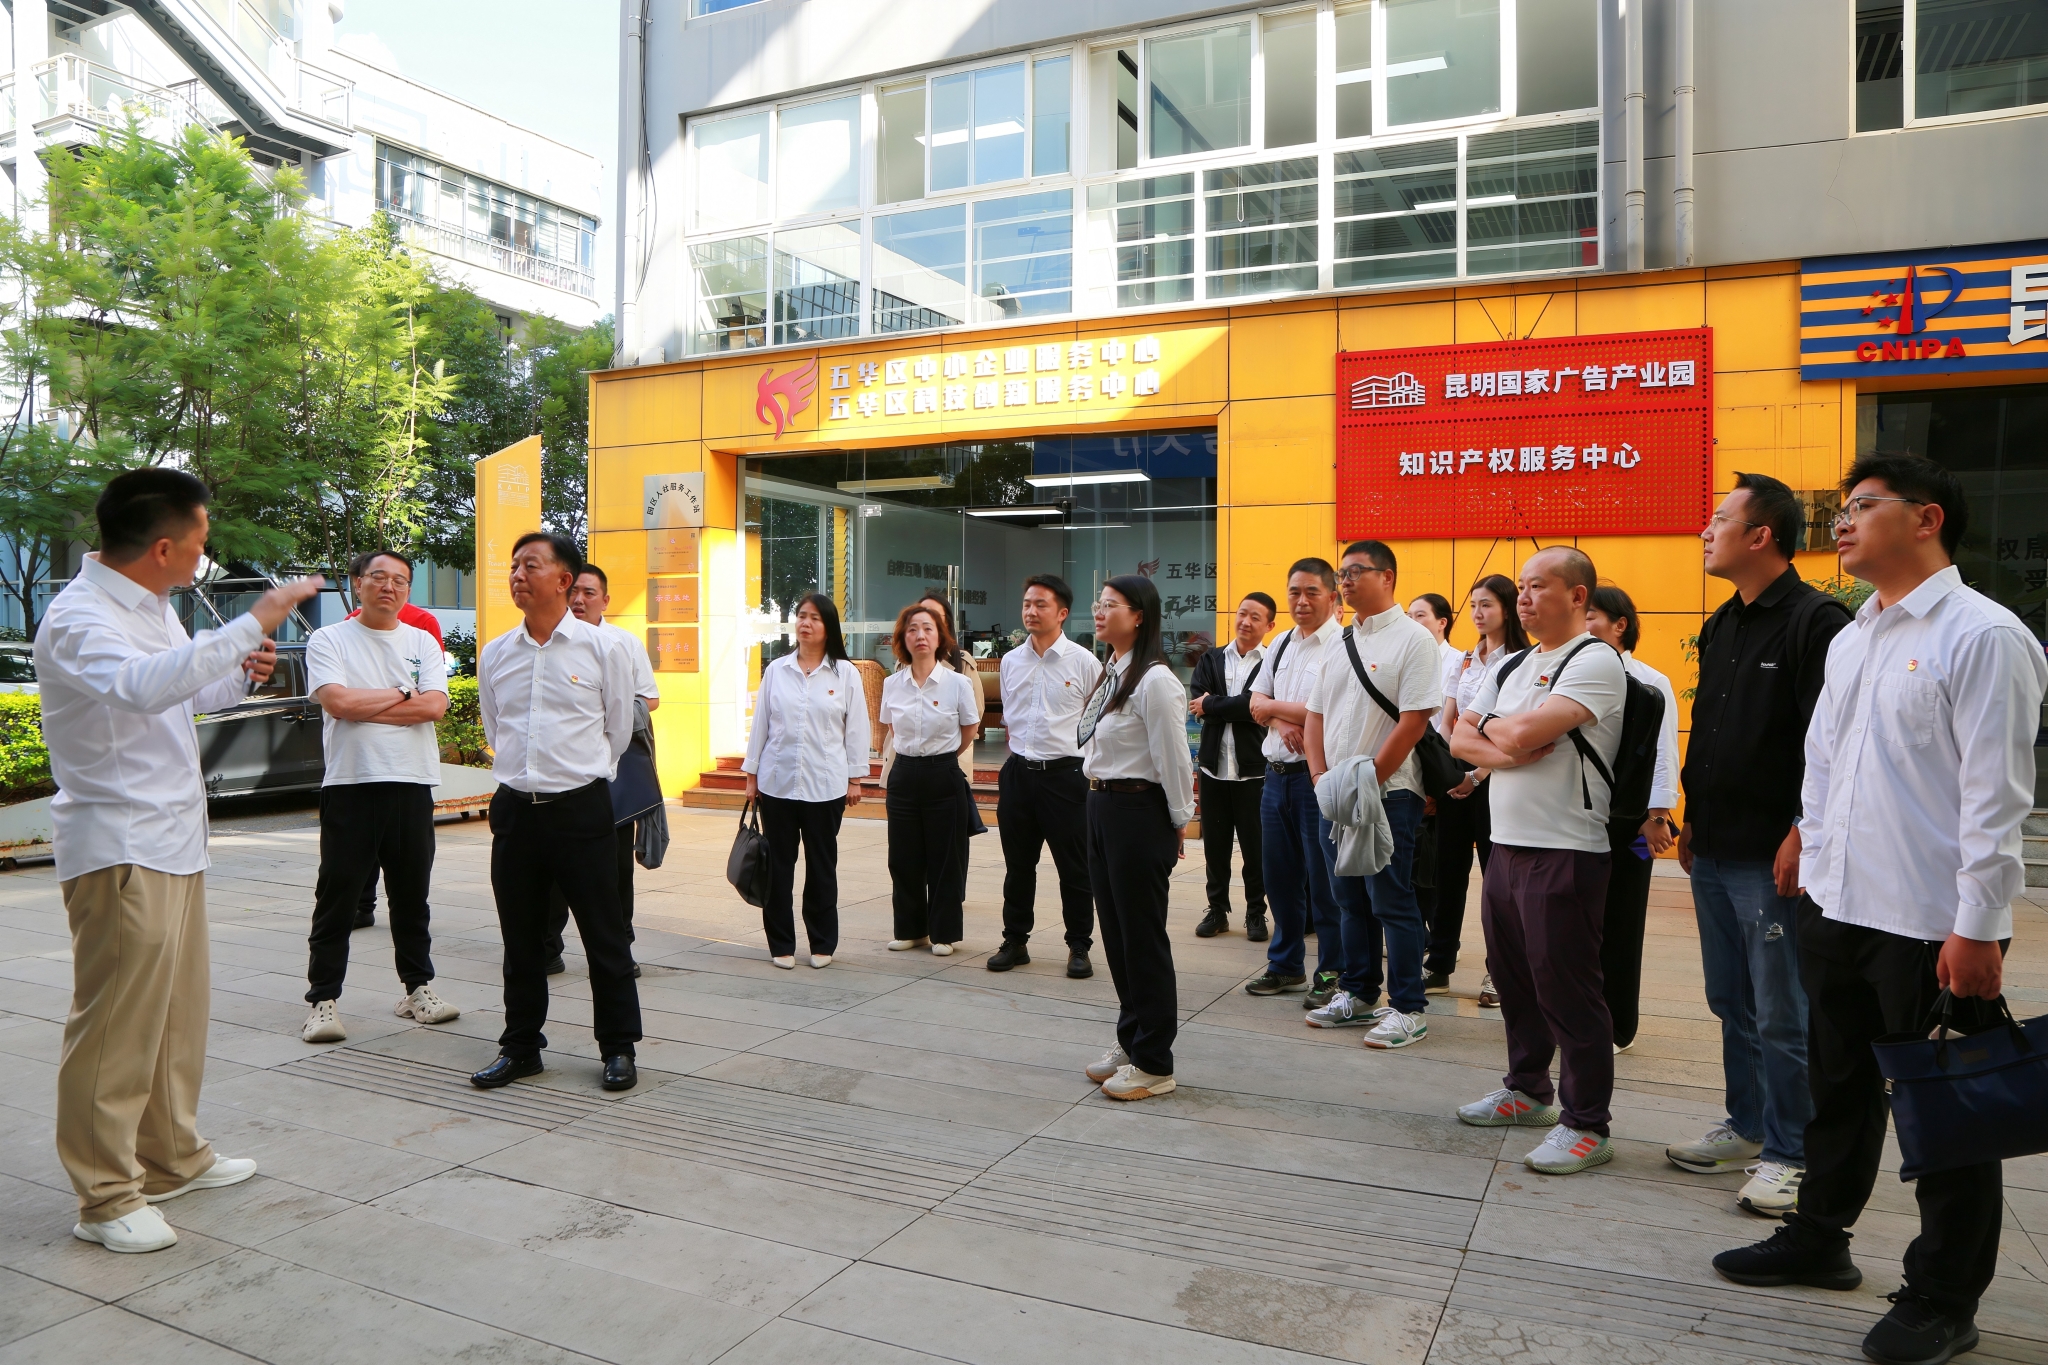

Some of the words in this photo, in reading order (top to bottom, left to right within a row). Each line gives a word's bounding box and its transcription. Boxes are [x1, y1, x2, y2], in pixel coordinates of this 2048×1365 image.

[829, 335, 1160, 390] 五华区中小企业服务中心
[1856, 337, 1966, 362] CNIPA
[828, 368, 1160, 421] 五华区科技创新服务中心
[1444, 360, 1695, 399] 昆明国家广告产业园
[1398, 442, 1641, 476] 知识产权服务中心
[497, 483, 530, 493] KAIP
[1166, 562, 1217, 580] 五华区
